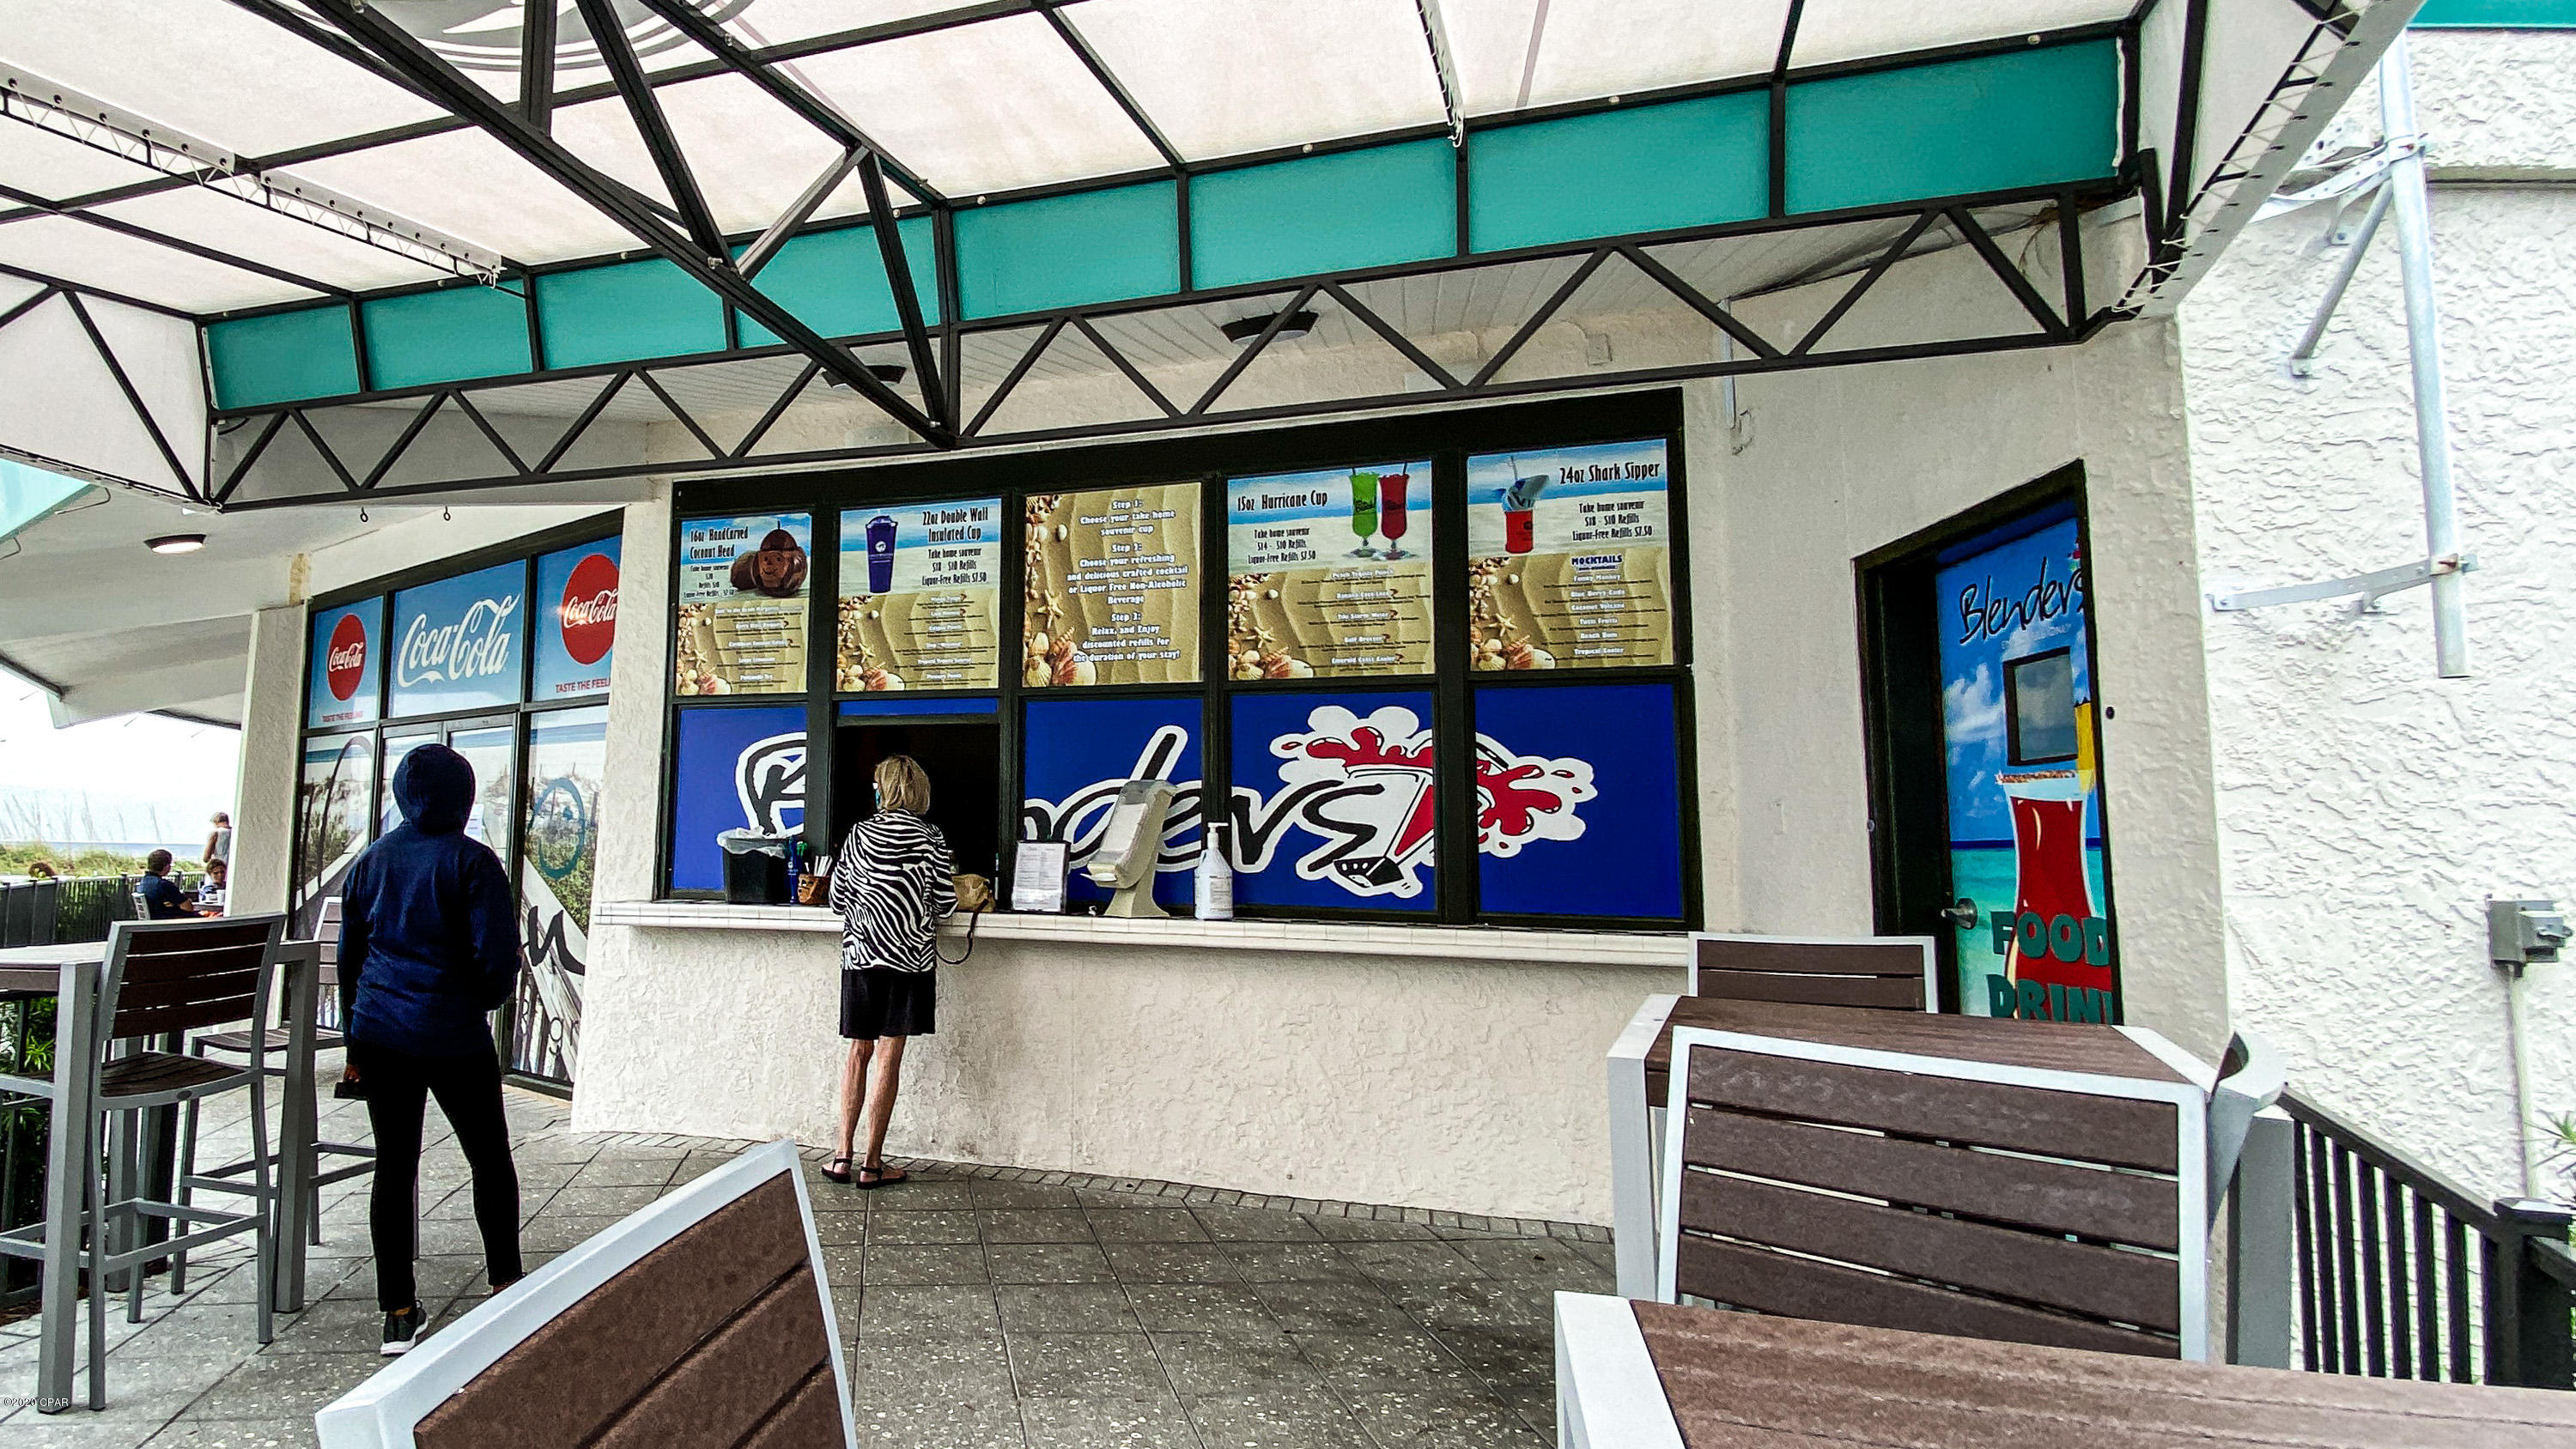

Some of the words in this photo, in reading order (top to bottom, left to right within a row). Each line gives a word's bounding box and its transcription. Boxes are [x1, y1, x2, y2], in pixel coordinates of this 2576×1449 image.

[1560, 466, 1584, 484] 24oz
[1589, 464, 1620, 482] Shark
[1625, 462, 1660, 481] Sipper
[1112, 500, 1131, 510] Step
[1238, 496, 1255, 511] 15oz
[1262, 493, 1307, 510] Hurricane
[1310, 489, 1327, 506] Cup
[1579, 503, 1595, 513] Take
[1597, 502, 1614, 512] home
[1617, 501, 1645, 511] souvenir
[922, 512, 938, 526] 22oz
[941, 508, 968, 524] Double
[970, 506, 988, 522] Wall
[1080, 515, 1108, 524] Choose
[1109, 513, 1129, 524] your
[1132, 512, 1150, 520] take
[1152, 510, 1176, 518] home
[1619, 513, 1640, 524] Refills
[929, 525, 964, 543] Insulated
[967, 525, 981, 541] Cup
[1101, 527, 1136, 537] souvenir
[1139, 525, 1154, 534] cup
[1255, 530, 1267, 539] Take
[1269, 529, 1285, 537] home
[1286, 528, 1310, 537] souvenir
[1612, 527, 1632, 538] Refills
[1111, 543, 1131, 553] Step
[1288, 539, 1306, 549] Refills
[690, 547, 716, 559] Coconut
[718, 544, 735, 557] Head
[928, 549, 940, 559] Take
[943, 549, 957, 558] home
[959, 549, 981, 557] souvenir
[1281, 552, 1298, 562] Refills
[960, 560, 977, 571] Refills
[1079, 558, 1108, 568] Choose
[1109, 557, 1129, 567] your
[1131, 555, 1176, 565] refreshing
[1571, 555, 1623, 565] MOCKTAILS
[953, 573, 970, 585] Refills
[1066, 573, 1082, 581] and
[1084, 570, 1120, 580] delicious
[1122, 567, 1153, 579] crafted
[1156, 565, 1188, 576] cocktail
[1068, 585, 1078, 594] or
[1080, 584, 1107, 594] Liquor
[1109, 582, 1127, 592] Free
[1130, 579, 1187, 591] Non-Alcoholic
[1108, 596, 1145, 604] Beverage
[1959, 556, 2084, 644] Blenders
[1111, 613, 1130, 622] Step
[1091, 627, 1118, 636] Relax,
[1120, 626, 1135, 634] and
[1137, 625, 1160, 634] Enjoy
[398, 594, 520, 688] Coca-Cola
[1082, 639, 1127, 649] discounted
[1129, 638, 1154, 647] refills
[1157, 637, 1170, 646] for
[329, 641, 364, 672] Coca-Cola
[1089, 652, 1124, 662] duration
[1127, 652, 1135, 660] of
[1138, 652, 1157, 661] your
[556, 682, 576, 693] TASTE
[577, 680, 591, 690] THE
[1990, 911, 2110, 967] FOOD
